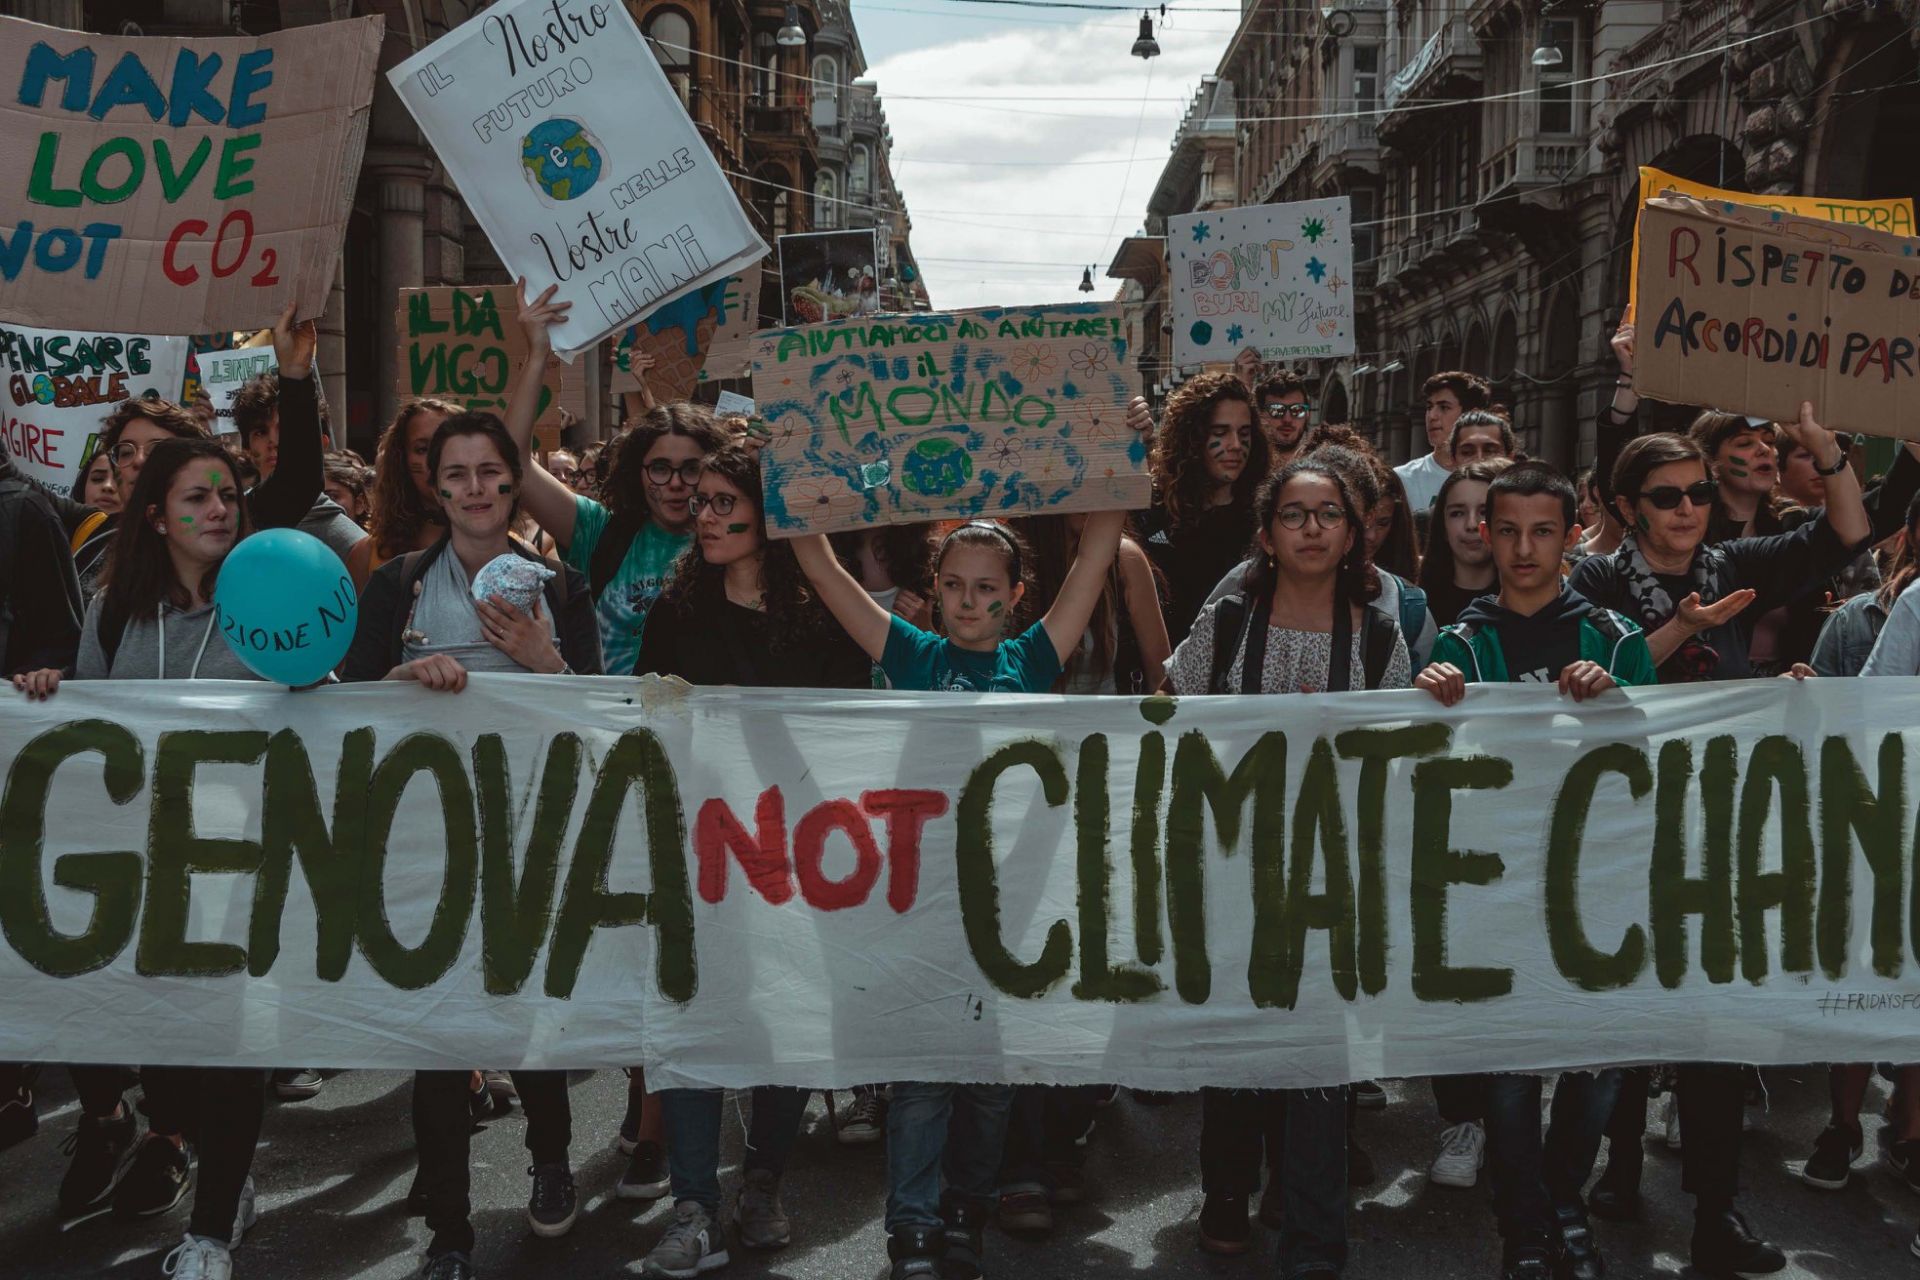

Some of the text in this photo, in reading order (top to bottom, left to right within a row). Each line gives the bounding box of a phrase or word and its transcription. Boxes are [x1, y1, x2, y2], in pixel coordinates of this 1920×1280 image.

[483, 0, 610, 77] Nostro
[17, 40, 274, 129] MAKE
[417, 62, 455, 97] IL
[472, 57, 593, 144] FUTURO
[27, 131, 261, 208] LOVE
[610, 147, 696, 210] NELLE
[530, 210, 639, 282] Vostre
[1189, 238, 1295, 291] DON'T
[958, 318, 989, 341] AD
[1193, 291, 1259, 317] BURN
[1262, 291, 1298, 325] MY
[1840, 331, 1920, 384] PAR
[9, 371, 131, 408] GLOBALE
[828, 380, 1057, 447] MONDO
[1, 409, 65, 469] AGIRE
[318, 575, 356, 638] NO
[0, 718, 698, 1002] GENOVA
[693, 784, 949, 914] NOT
[1544, 730, 1920, 994] CHAN
